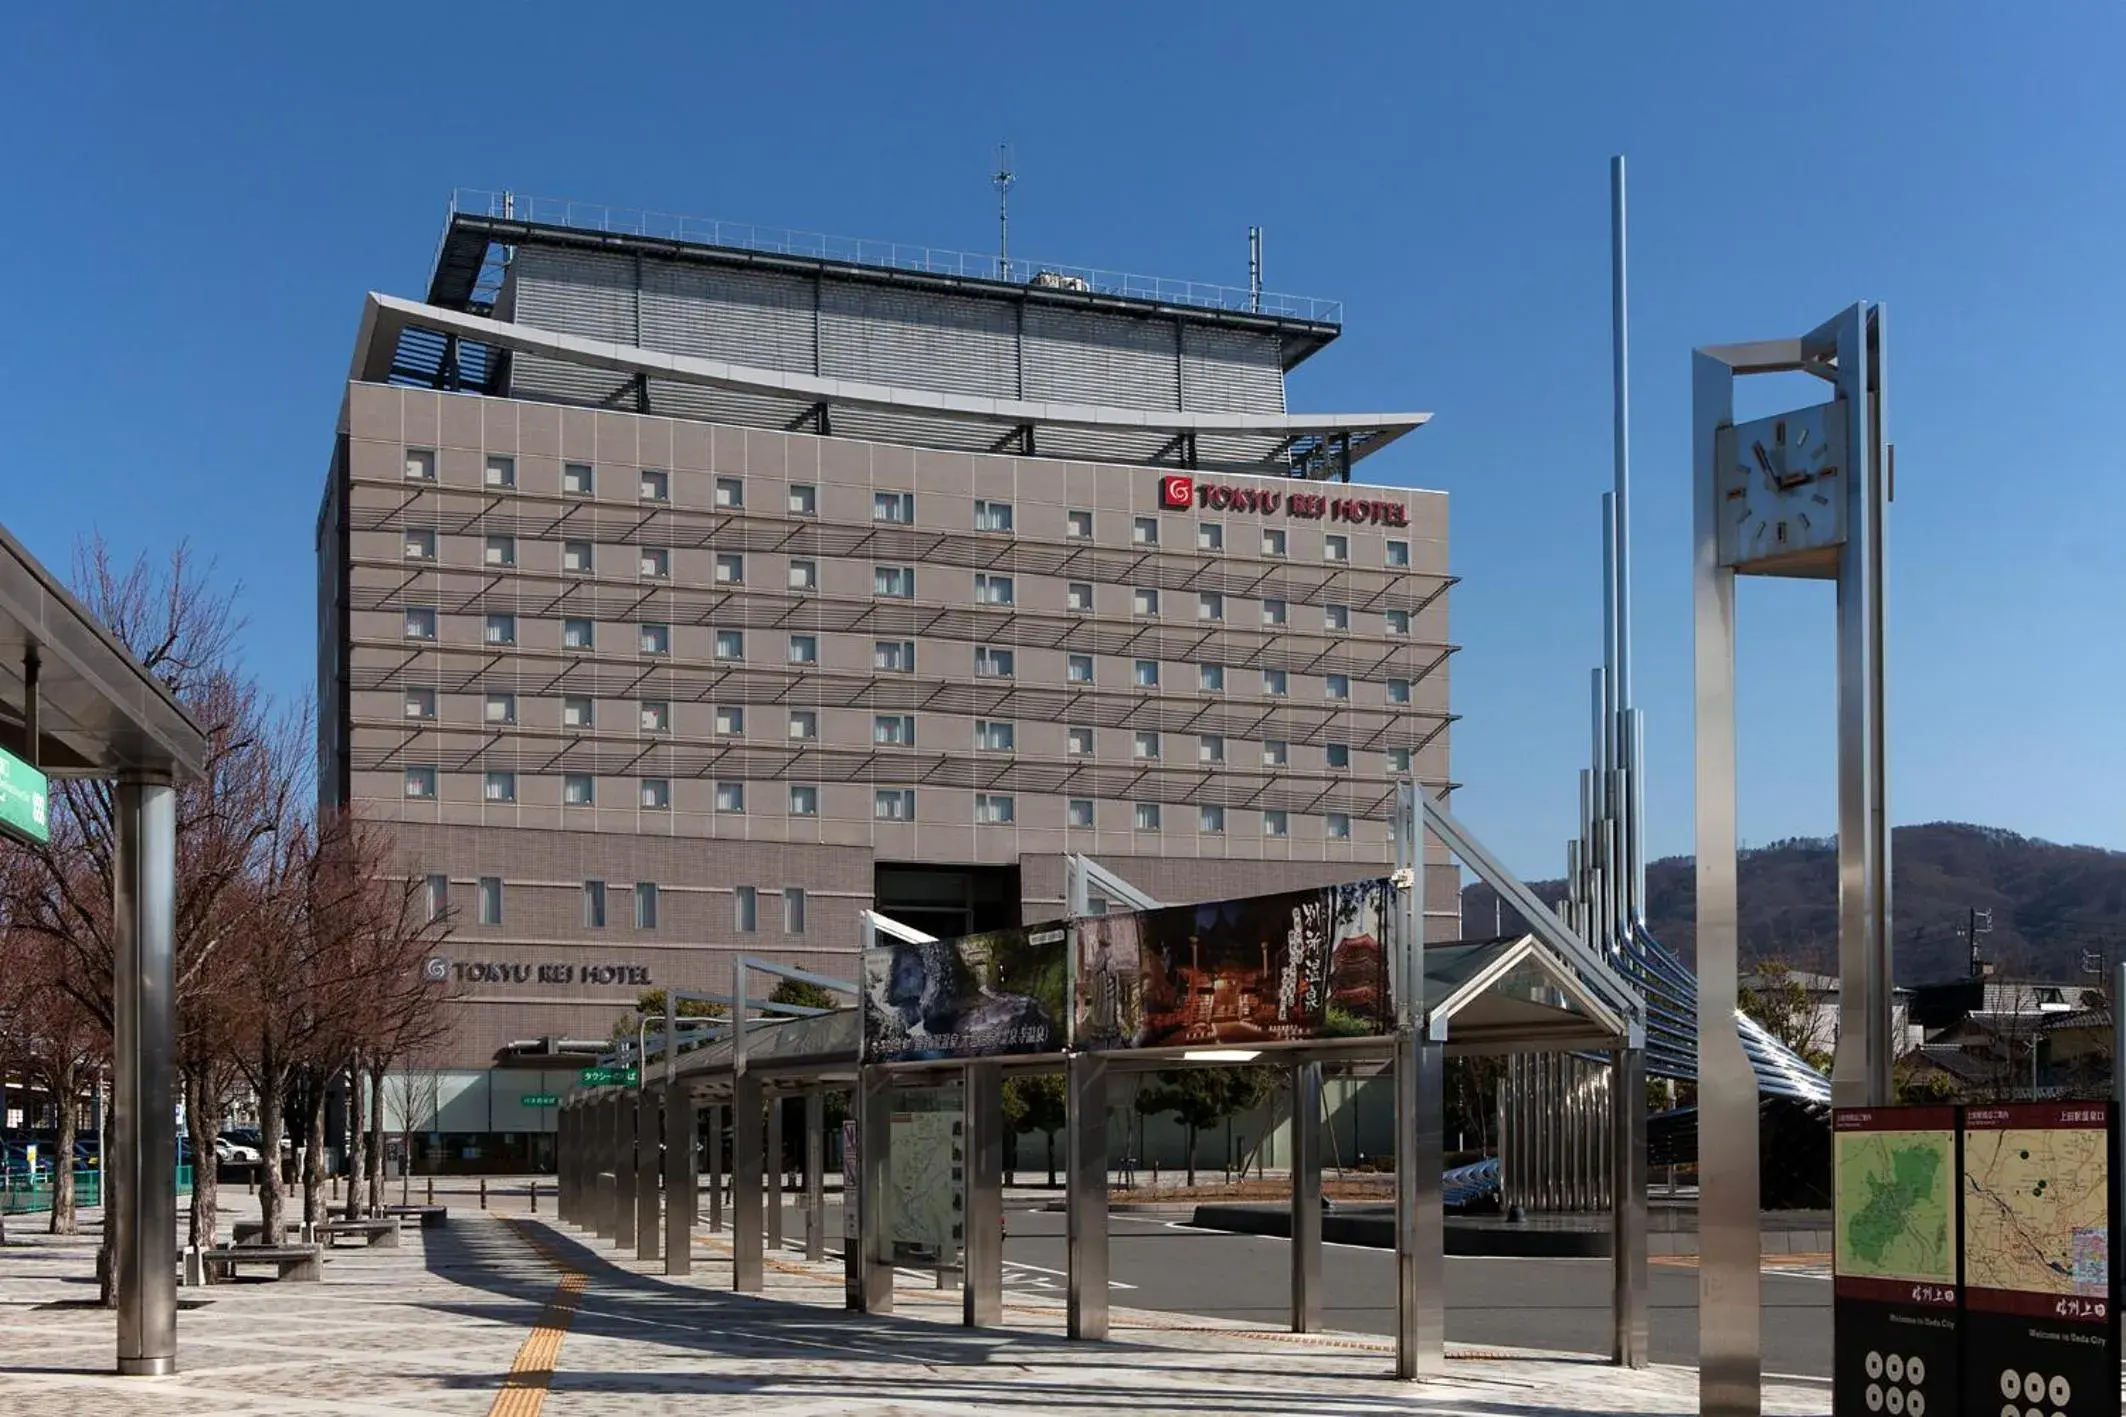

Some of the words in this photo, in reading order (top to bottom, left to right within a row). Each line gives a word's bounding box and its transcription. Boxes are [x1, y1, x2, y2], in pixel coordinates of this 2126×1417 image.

[1195, 483, 1281, 515] TOKYU
[1287, 493, 1326, 520] REI
[1331, 498, 1410, 527] HOTEL
[1301, 901, 1322, 1013] 別所温泉
[452, 961, 531, 984] TOKYU
[537, 963, 574, 984] REI
[580, 965, 652, 985] HOTEL
[584, 1072, 637, 1081] タクシーのば
[2090, 1335, 2107, 1347] City
